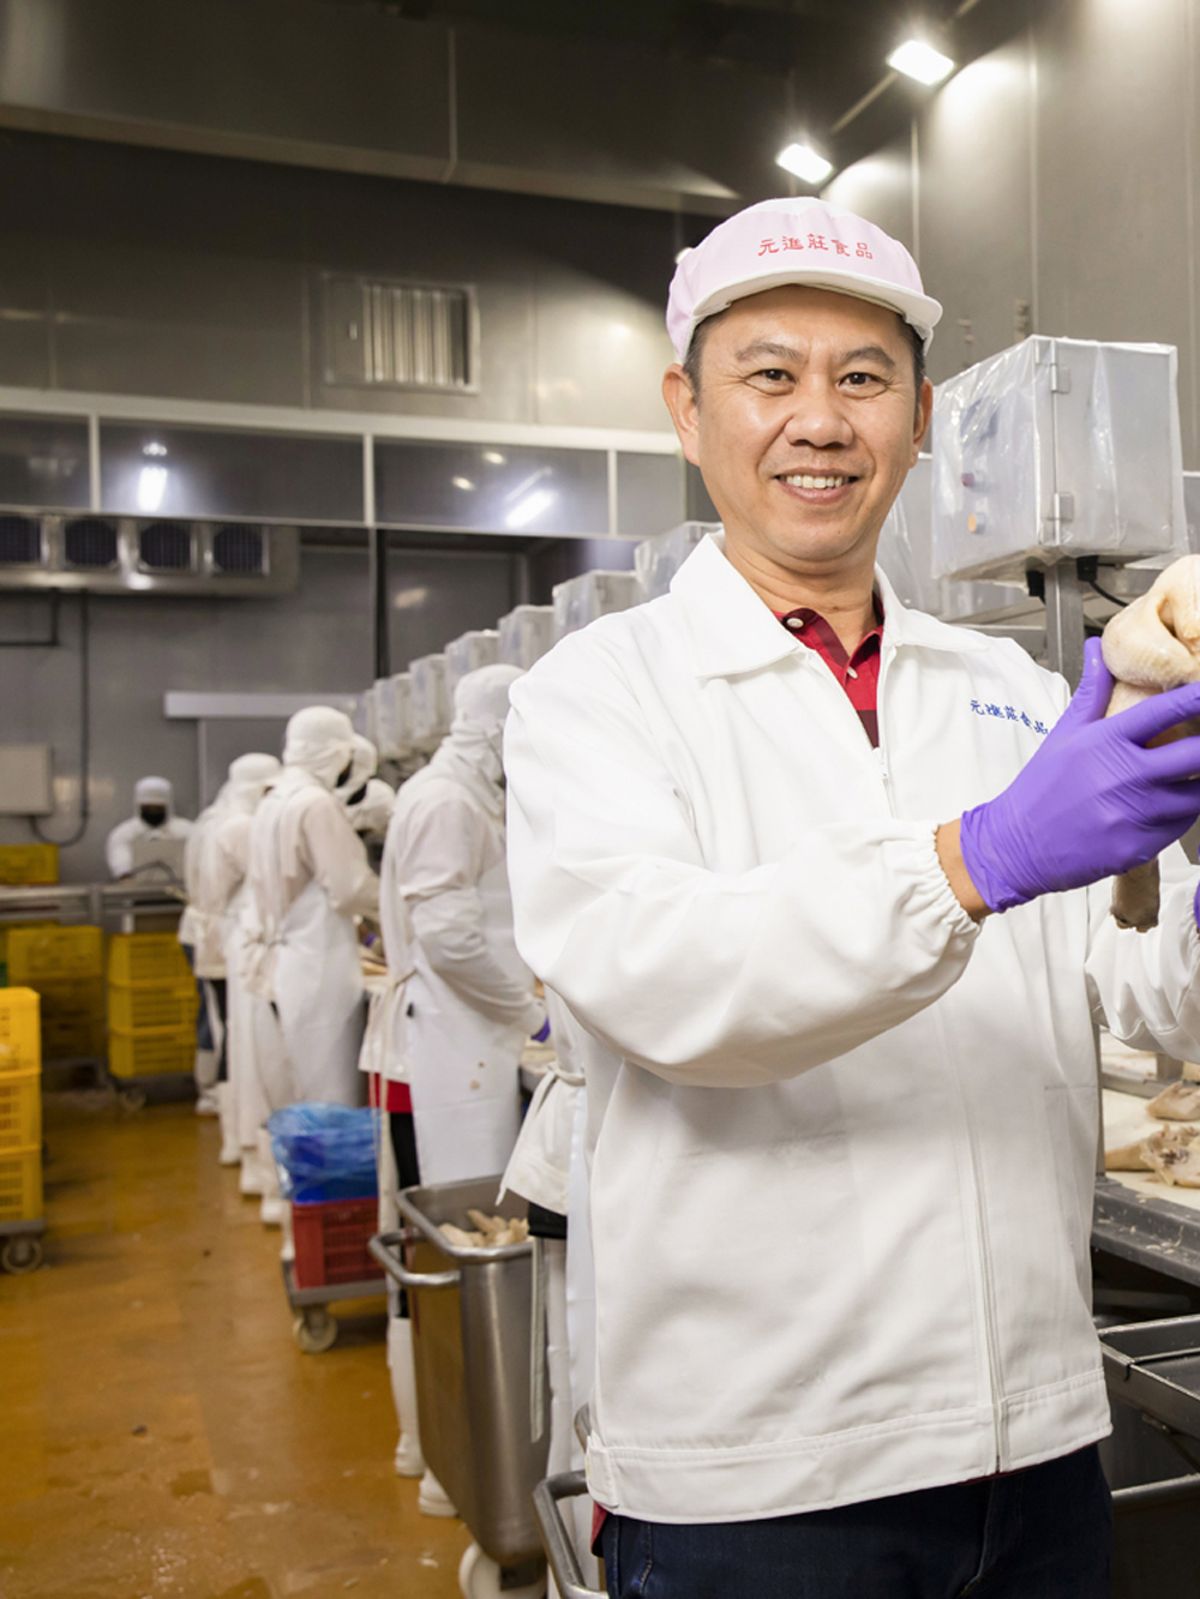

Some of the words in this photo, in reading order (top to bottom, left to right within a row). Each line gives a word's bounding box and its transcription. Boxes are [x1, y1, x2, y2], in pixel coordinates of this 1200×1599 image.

[757, 233, 873, 260] 元進莊食品
